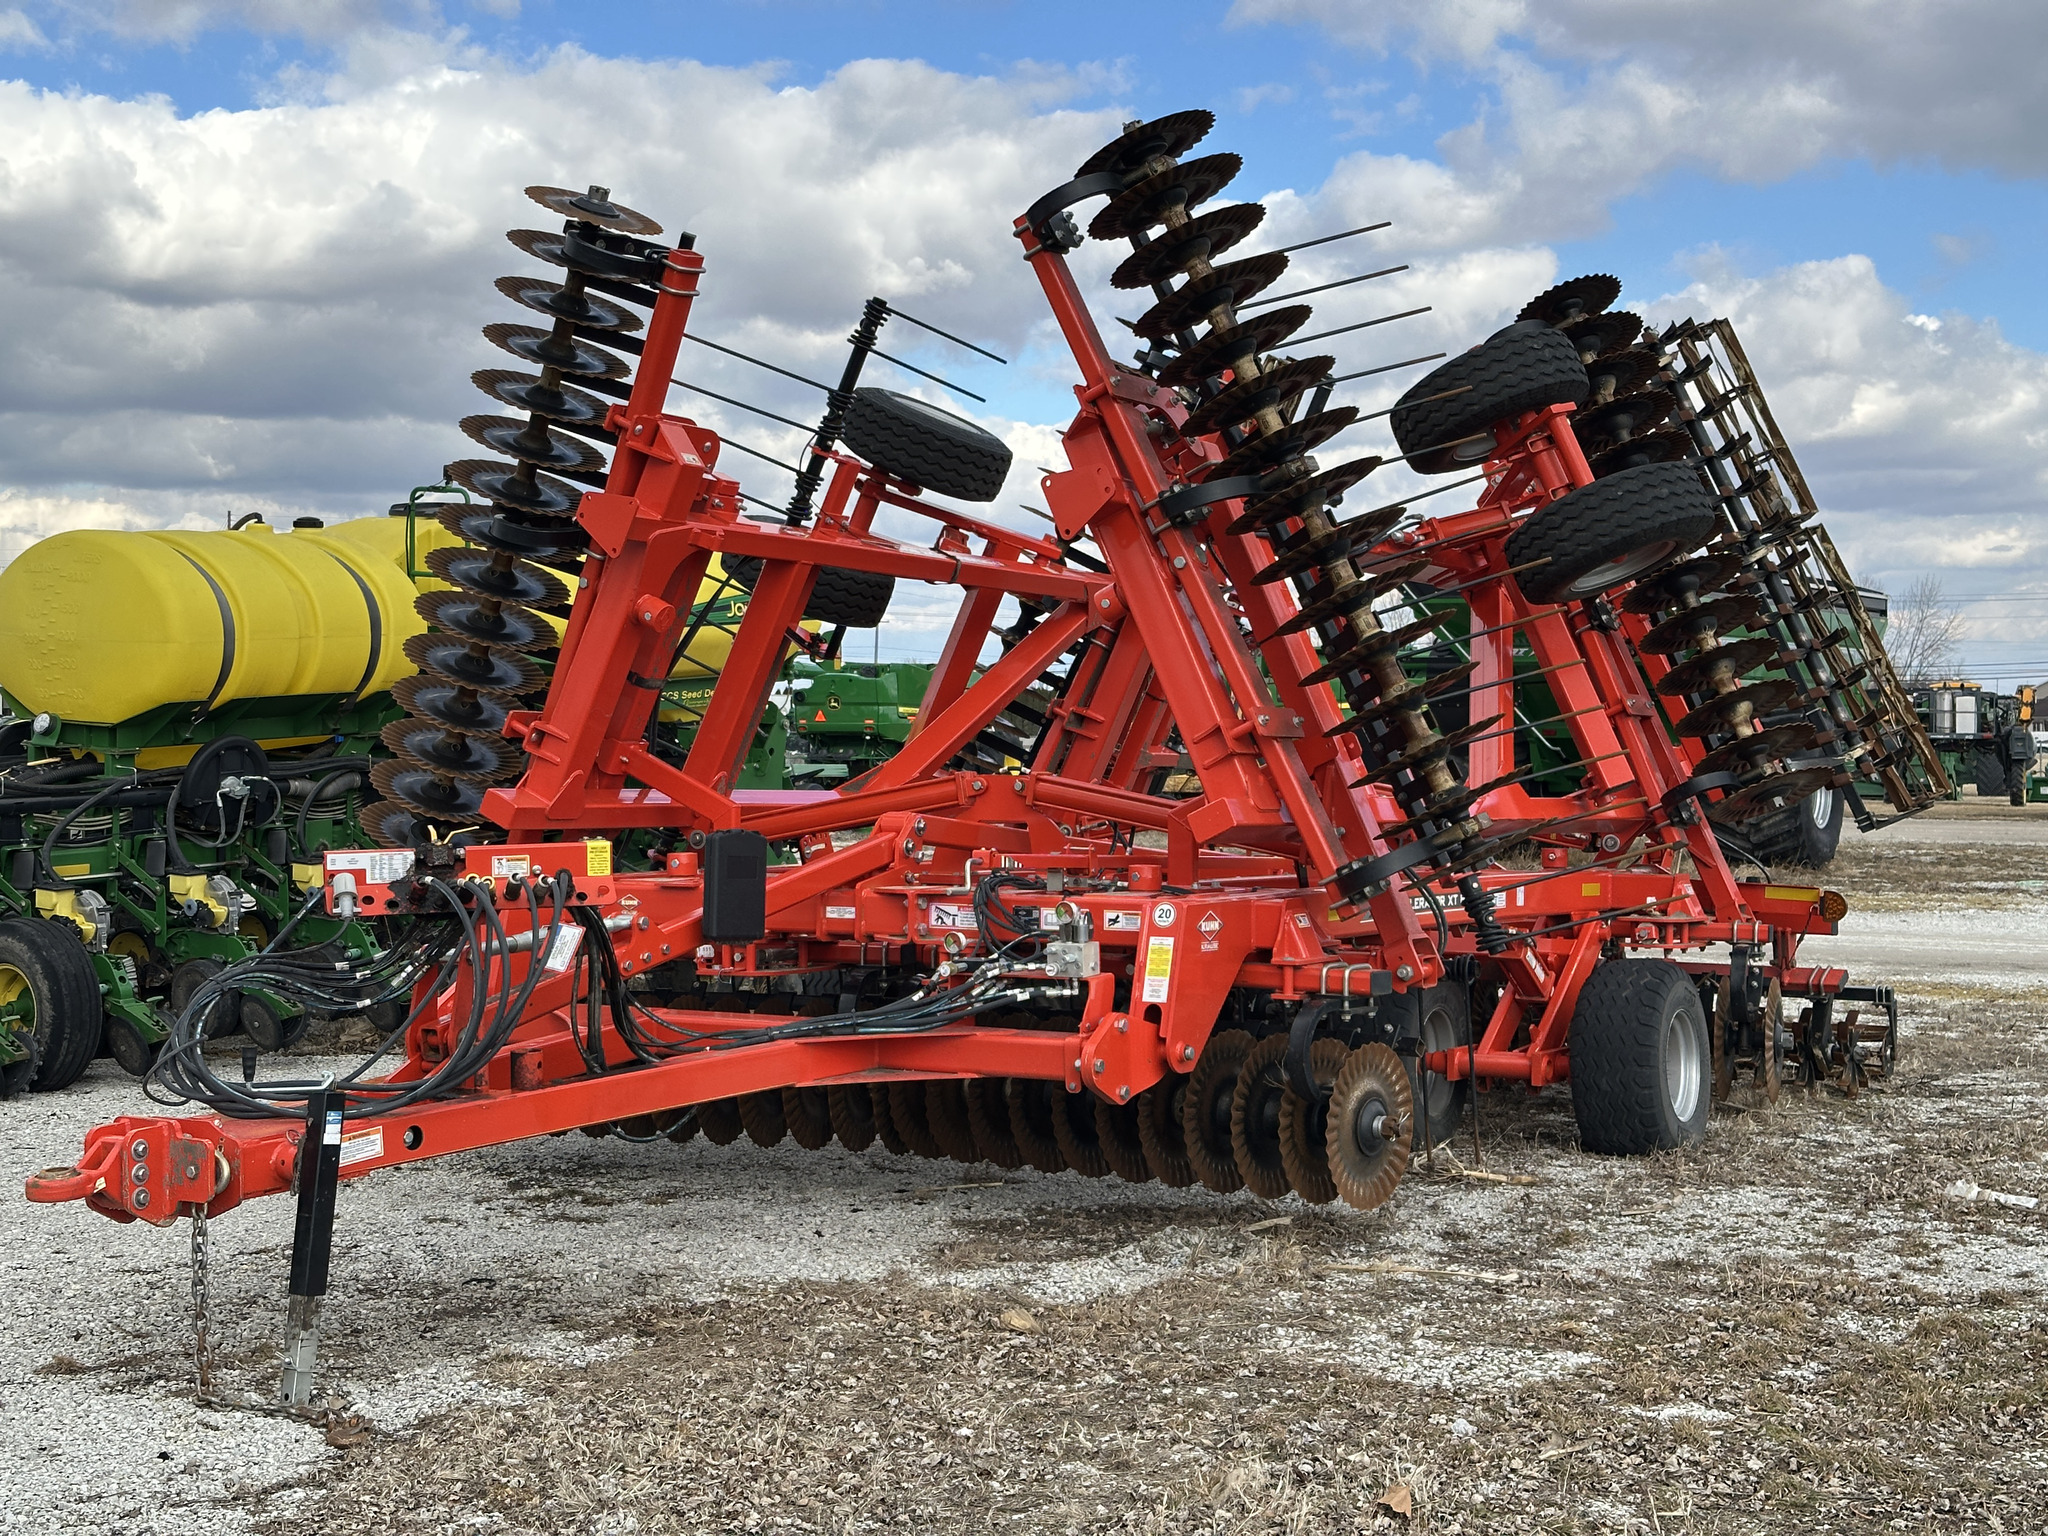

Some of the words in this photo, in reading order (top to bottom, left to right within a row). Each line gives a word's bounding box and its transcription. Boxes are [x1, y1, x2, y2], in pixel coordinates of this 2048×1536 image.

[681, 688, 703, 700] Seed
[1447, 894, 1459, 906] XT
[1157, 908, 1172, 919] 20
[1201, 920, 1220, 931] KUHN
